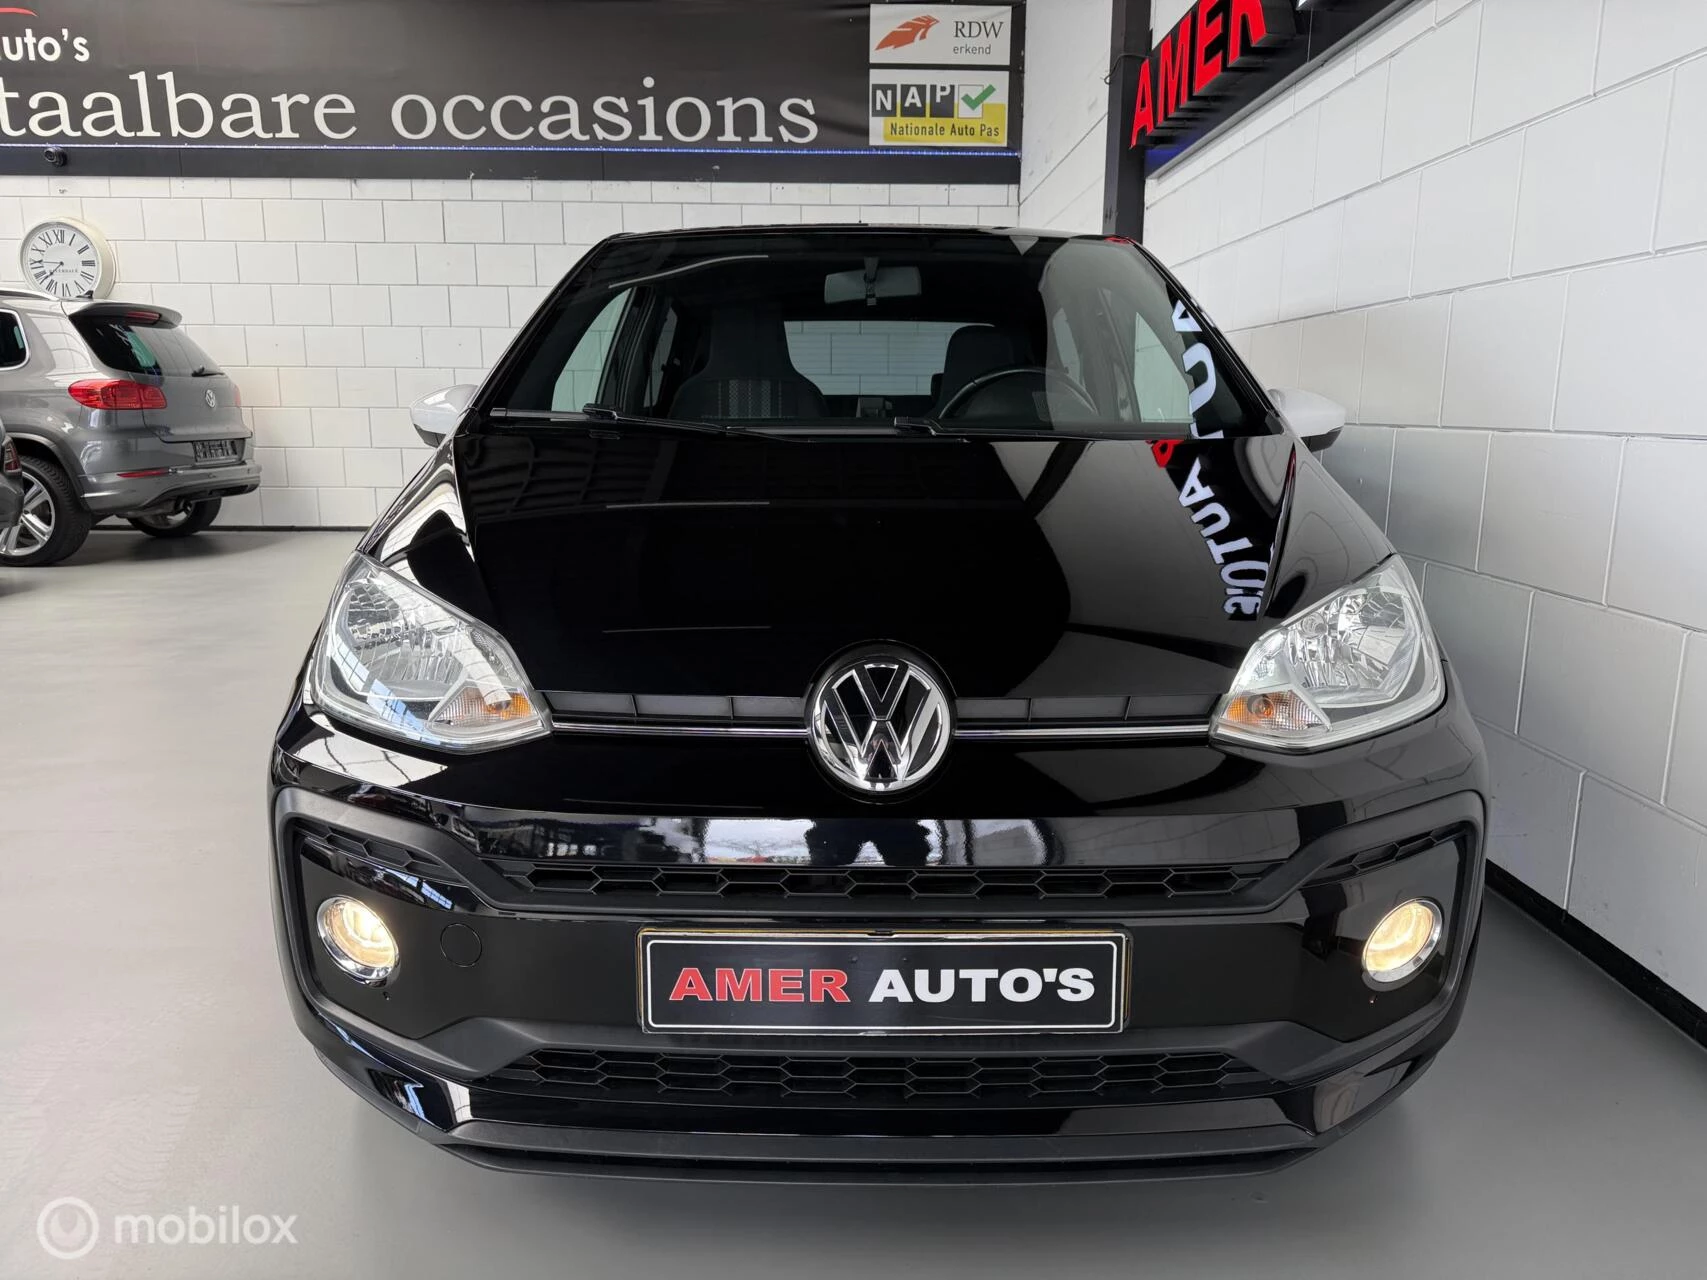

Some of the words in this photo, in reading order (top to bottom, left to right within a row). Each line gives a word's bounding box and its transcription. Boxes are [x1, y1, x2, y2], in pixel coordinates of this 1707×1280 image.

[953, 20, 1004, 39] RDW
[0, 28, 90, 62] uto's
[953, 44, 991, 55] erkend
[391, 76, 819, 143] occasions
[890, 122, 945, 136] Nationale
[950, 124, 975, 136] Auto
[979, 124, 1000, 137] Pas
[669, 967, 851, 1003] AMER
[869, 967, 1095, 1003] AUTO'S
